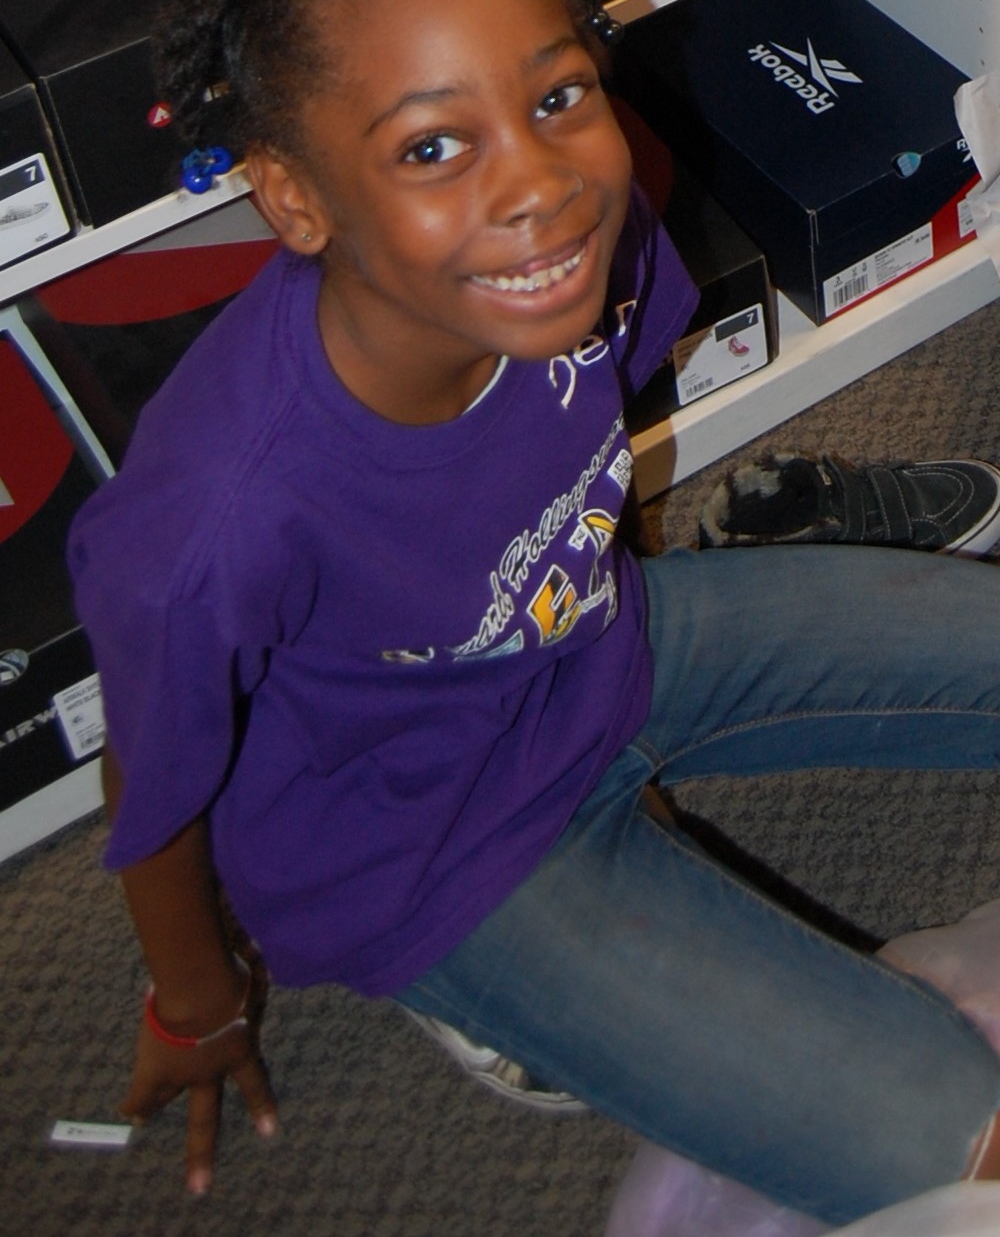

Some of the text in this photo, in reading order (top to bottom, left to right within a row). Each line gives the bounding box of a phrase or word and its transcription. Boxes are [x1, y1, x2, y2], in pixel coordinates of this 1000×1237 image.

[748, 43, 835, 114] Reebok
[25, 165, 37, 182] 7
[747, 312, 754, 324] 7
